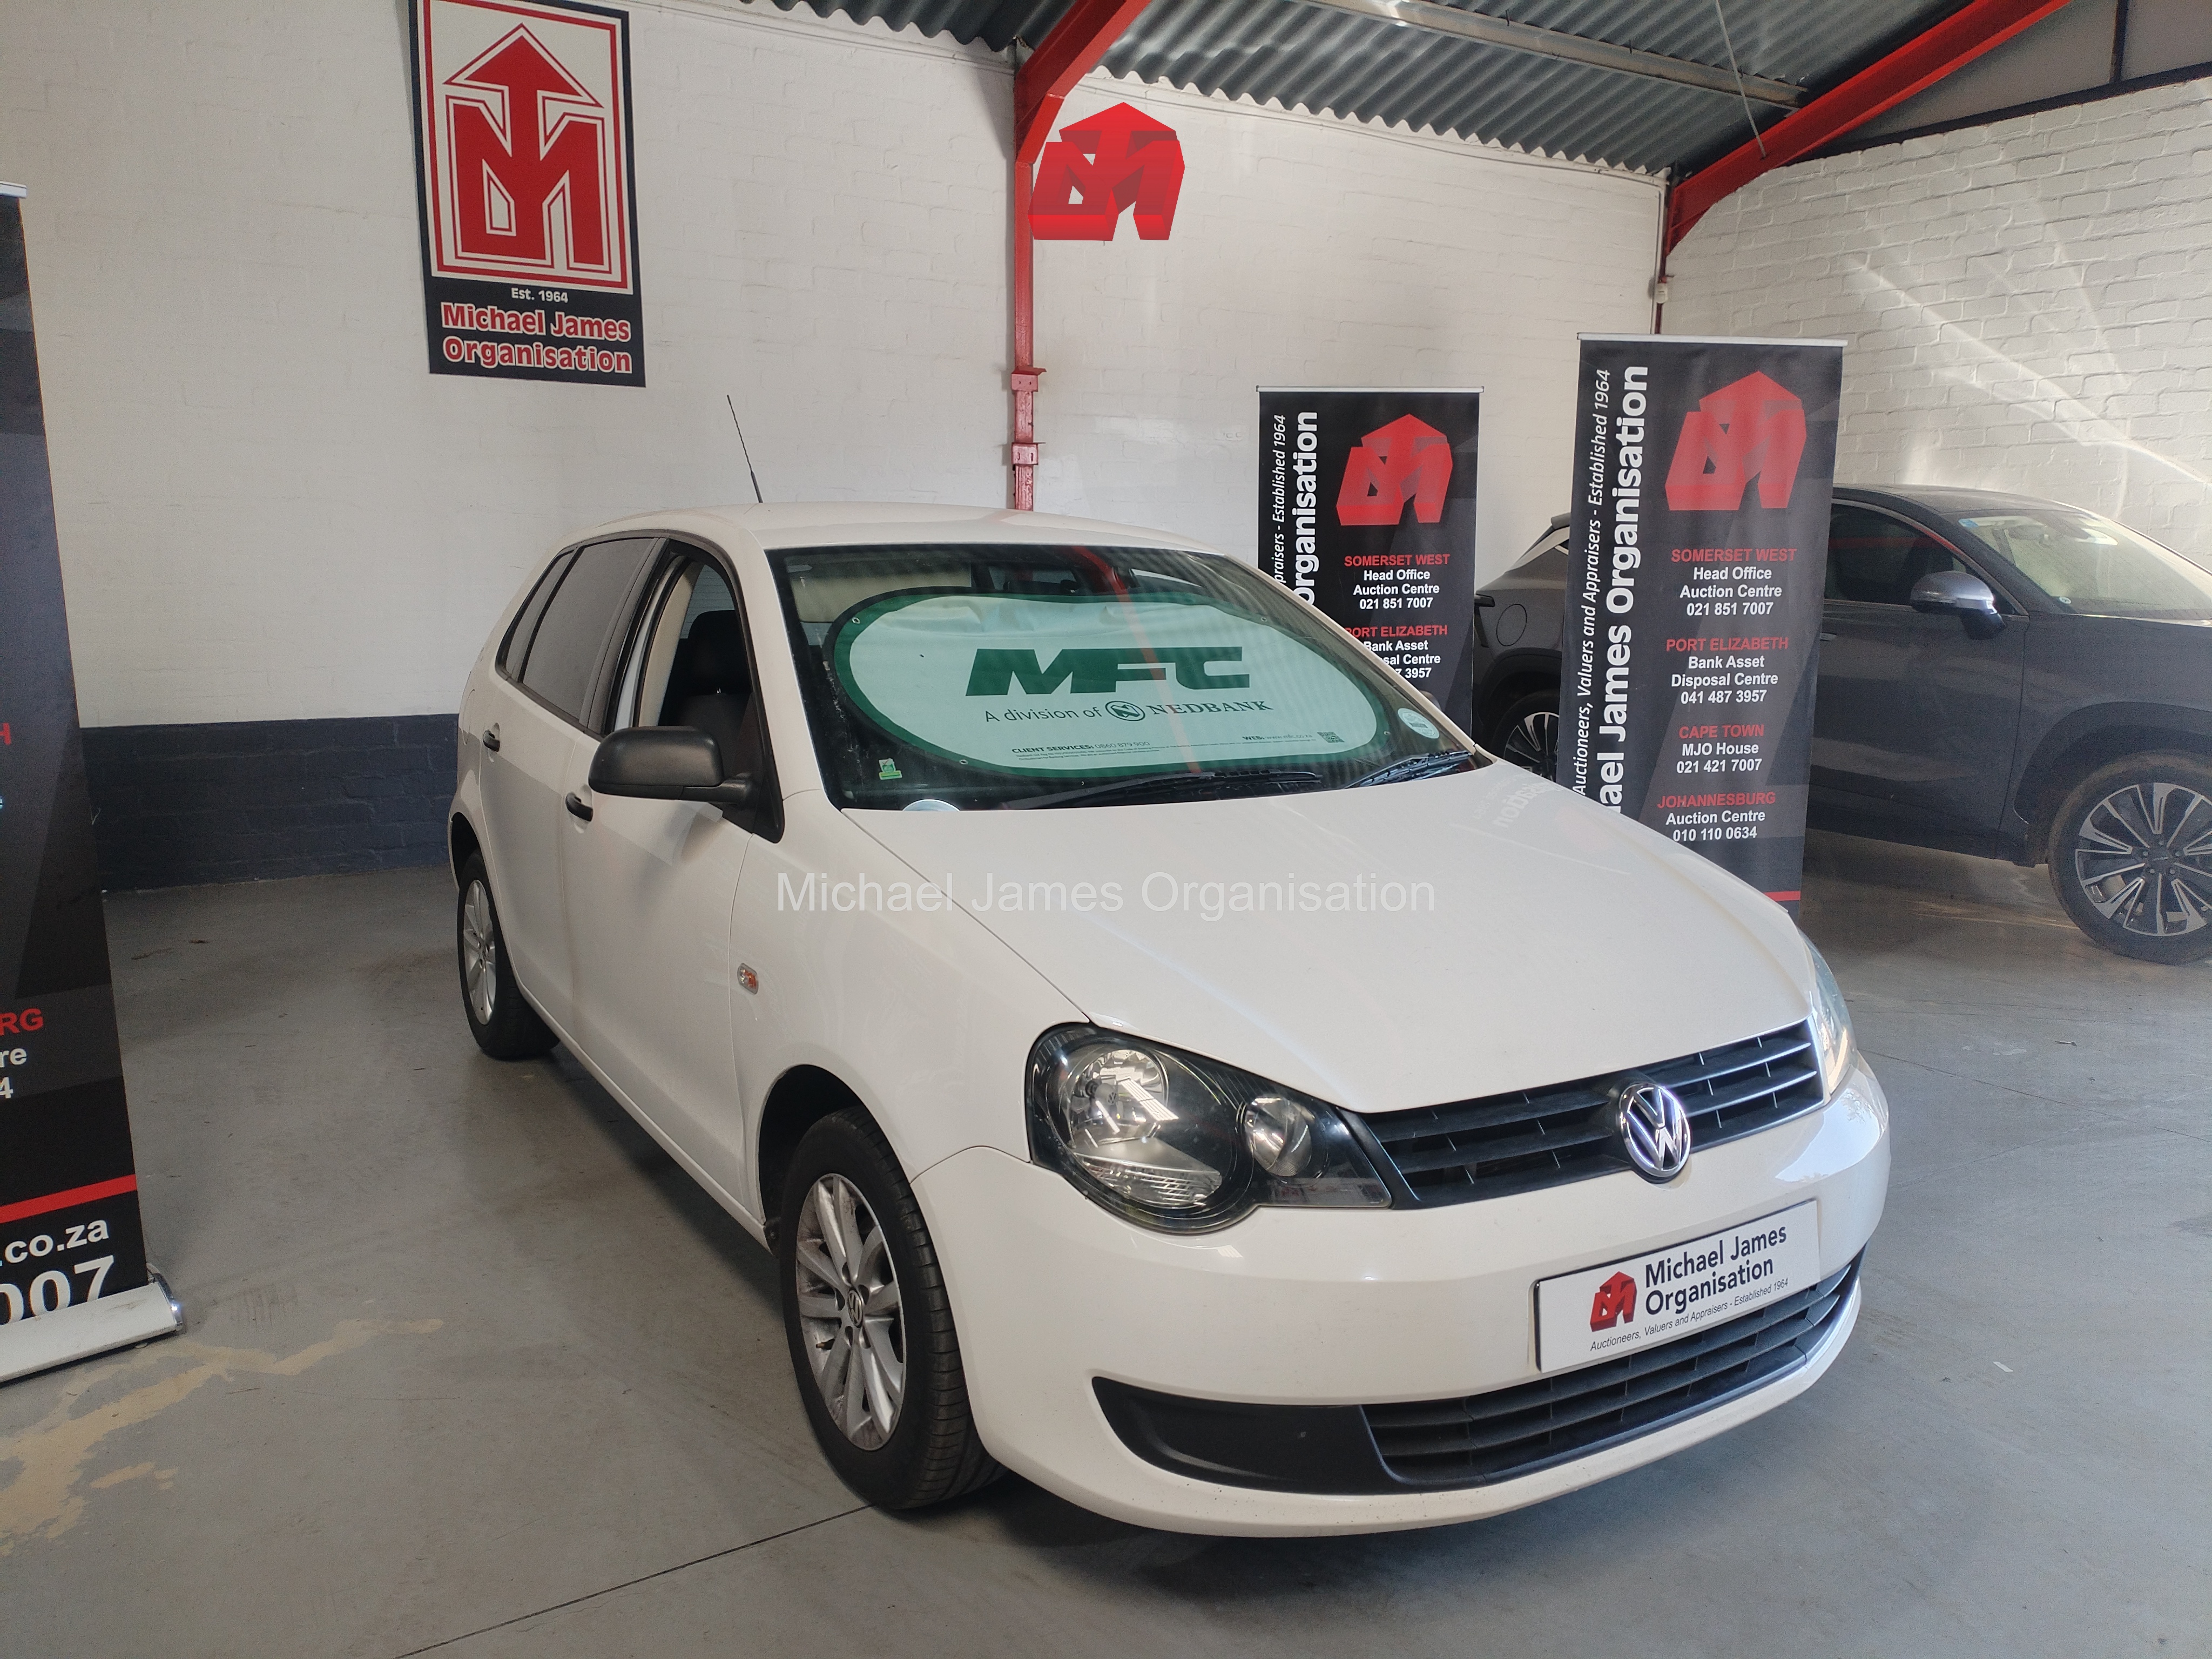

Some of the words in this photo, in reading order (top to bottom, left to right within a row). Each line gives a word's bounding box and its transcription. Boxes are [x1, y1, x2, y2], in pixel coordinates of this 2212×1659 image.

[511, 287, 535, 301] Est.
[538, 289, 569, 304] 1964
[441, 301, 546, 335] Michael
[550, 312, 631, 343] James
[443, 335, 633, 374] Organisation
[1595, 368, 1610, 409] 1964
[1273, 414, 1286, 447] 1964
[1588, 413, 1607, 506] Established
[1272, 449, 1285, 522] Established
[1606, 366, 1648, 613] Organisation
[1344, 555, 1413, 567] SOMERSET
[1415, 554, 1451, 565] WEST
[1582, 518, 1601, 603] Appraisers
[1671, 549, 1752, 562] SOMERSET
[1756, 548, 1797, 562] WEST
[1364, 570, 1393, 581] Head
[1397, 569, 1430, 580] Office
[1694, 567, 1728, 580] Head
[1732, 567, 1772, 579] Office
[1353, 584, 1399, 595] Auction
[1401, 583, 1440, 594] Centre
[1680, 585, 1733, 598] Auction
[1737, 584, 1782, 597] Centre
[1359, 598, 1379, 609] 021
[1382, 598, 1402, 609] 851
[1406, 597, 1433, 608] 7007
[1687, 603, 1710, 616] 021
[1714, 602, 1737, 615] 851
[1742, 602, 1774, 615] 7007
[1583, 605, 1596, 637] and
[1380, 625, 1448, 637] ELIZABETH
[1363, 640, 1393, 651] Bank
[1395, 640, 1429, 651] Asset
[1665, 638, 1707, 652] PORT
[1710, 637, 1789, 651] ELIZABETH
[1403, 653, 1441, 665] Centre
[1688, 656, 1723, 669] Bank
[1725, 655, 1765, 668] Asset
[965, 646, 1250, 697] MFC
[1405, 667, 1432, 678] 3957
[1577, 639, 1594, 697] Valuers
[1599, 625, 1631, 742] James
[1671, 673, 1730, 689] Disposal
[1734, 672, 1778, 685] Centre
[1681, 691, 1703, 704] 041
[1708, 690, 1732, 704] 487
[1736, 689, 1767, 703] 3957
[985, 711, 999, 723] A
[1004, 708, 1080, 722] division
[1083, 707, 1102, 718] of
[1145, 700, 1273, 716] NEDBANK
[1678, 725, 1718, 739] CAPE
[1722, 724, 1764, 738] TOWN
[1573, 703, 1594, 795] Auctioneers,
[1682, 743, 1712, 756] MJO
[1716, 742, 1759, 755] House
[1676, 760, 1699, 774] 021
[1703, 759, 1725, 772] 421
[1731, 758, 1762, 772] 7007
[1657, 792, 1776, 809] JOHANNESBURG
[1665, 812, 1718, 825] Auction
[1721, 810, 1766, 823] Centre
[1673, 829, 1696, 842] 010
[1701, 828, 1722, 840] 110
[1725, 826, 1757, 839] 0634
[1645, 1240, 1724, 1287] Michael
[1730, 1225, 1788, 1261] James
[1645, 1257, 1773, 1316] Organisation
[1590, 1331, 1642, 1351] Auctioneers,
[1644, 1321, 1673, 1336] Valuers
[1675, 1313, 1689, 1326] and
[1690, 1302, 1728, 1323] Appraisers
[1734, 1285, 1772, 1306] Established
[1773, 1278, 1789, 1291] 1964
